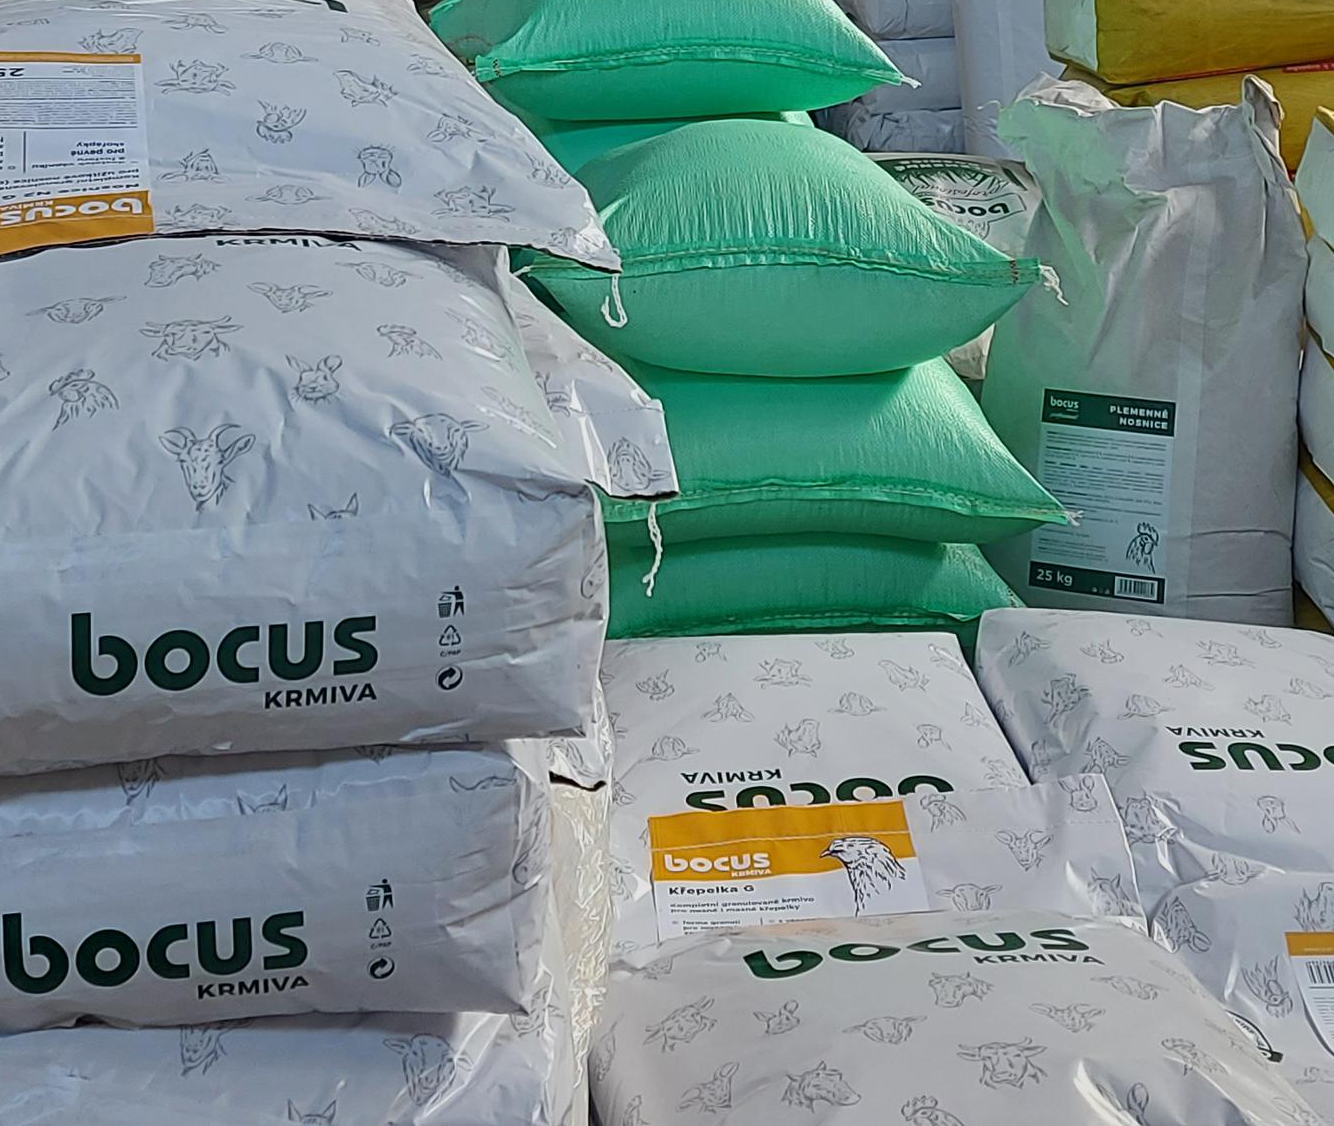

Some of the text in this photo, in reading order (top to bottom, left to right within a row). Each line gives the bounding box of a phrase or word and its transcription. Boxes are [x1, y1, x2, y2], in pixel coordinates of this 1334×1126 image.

[217, 238, 362, 251] KRMIVA
[1050, 396, 1079, 410] bocus
[1110, 405, 1169, 419] PLEMENNÉ
[1119, 417, 1168, 430] NOSNICE
[1036, 569, 1073, 585] 25 kg
[71, 613, 378, 697] bocus
[265, 682, 377, 709] KRMIVA
[1166, 723, 1265, 740] KRMIVA
[681, 768, 781, 783] KRMIVA
[664, 852, 771, 872] bocus
[731, 869, 772, 877] KRMIVA
[669, 885, 738, 895] Křepelka
[3, 911, 308, 995] bocus
[741, 926, 1088, 980] bocus
[972, 951, 1105, 969] KRMIVA
[197, 974, 310, 1001] KRMIVA
